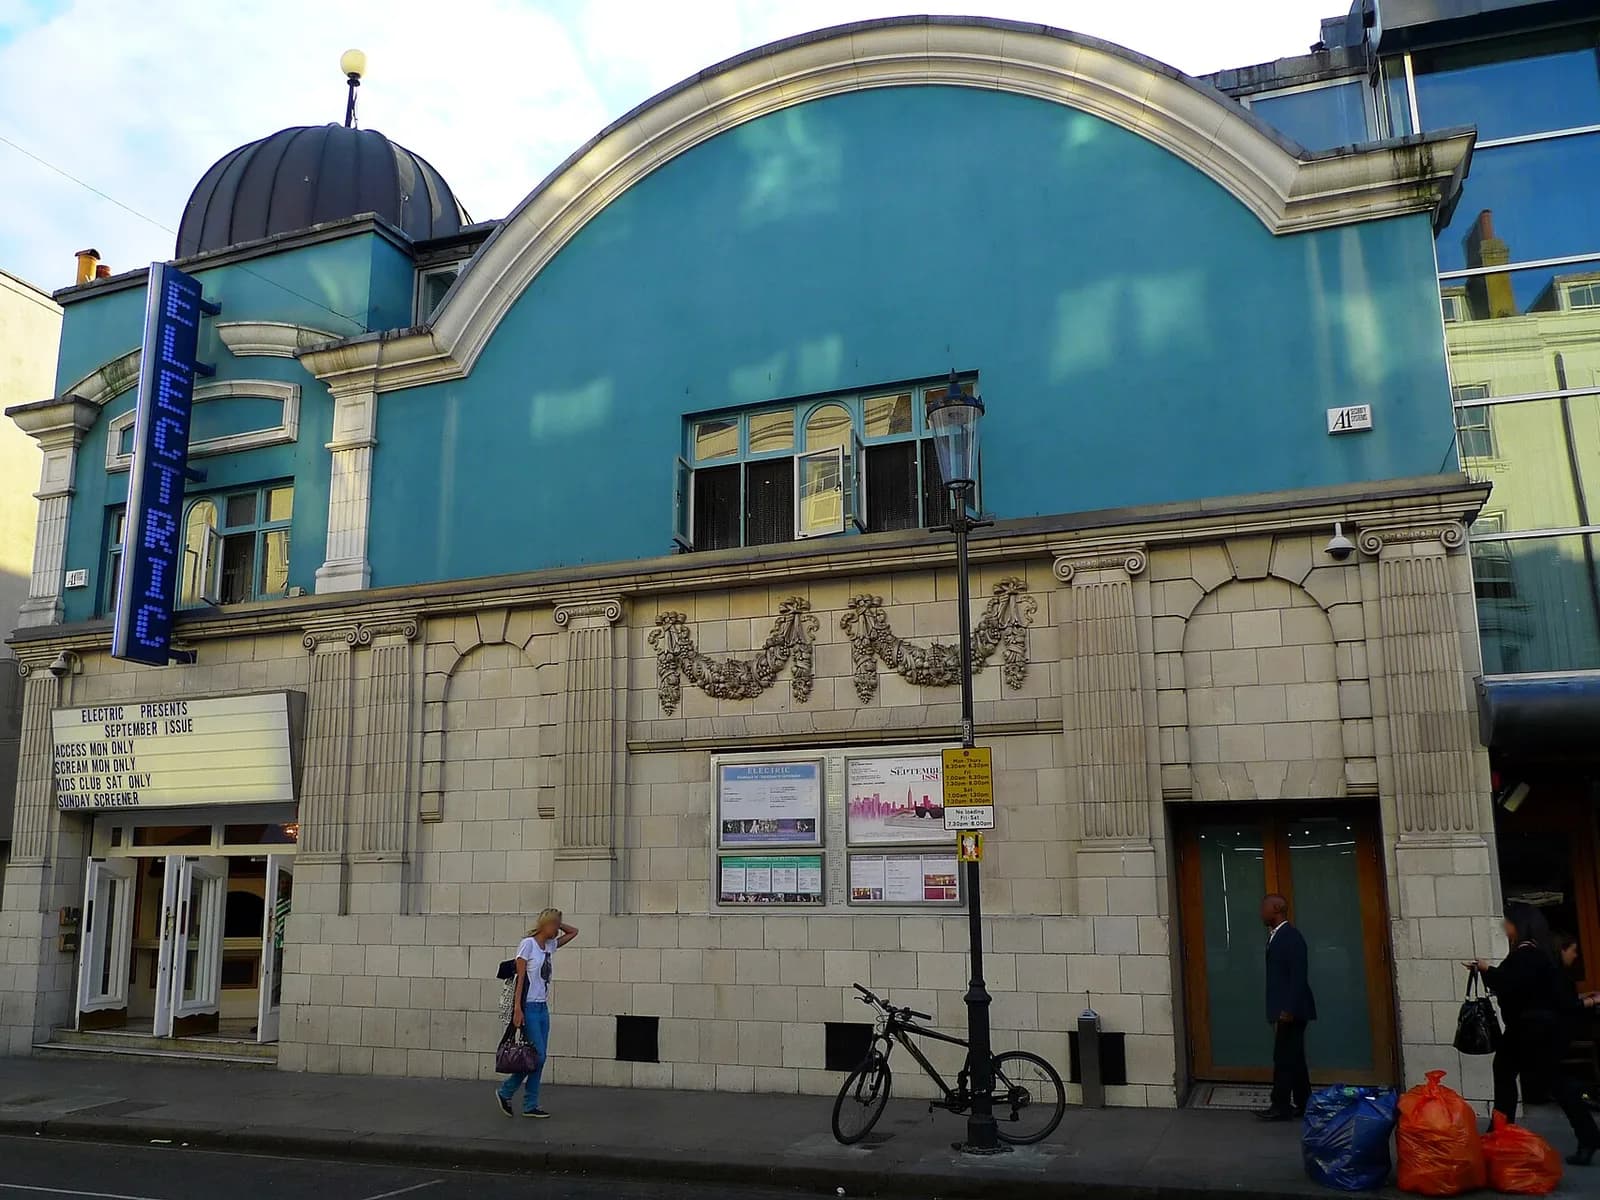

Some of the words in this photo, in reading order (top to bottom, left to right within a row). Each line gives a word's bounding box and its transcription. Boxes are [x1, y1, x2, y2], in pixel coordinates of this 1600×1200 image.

[1333, 409, 1352, 430] A1
[136, 280, 197, 648] ELECTRIC
[82, 707, 124, 723] ELECTRIC
[140, 702, 188, 718] PRESENTS
[104, 722, 158, 738] SEPTEMBER
[165, 719, 192, 734] ISSUE
[56, 743, 86, 758] ACCESS
[90, 742, 108, 756] MON
[112, 740, 134, 755] ONLY
[55, 760, 88, 775] SCREAM
[92, 758, 110, 773] MON
[114, 757, 136, 772] ONLY
[747, 766, 790, 775] ELECTRIC
[890, 767, 938, 776] SEPTEMB
[56, 778, 76, 792] KIDS
[80, 776, 100, 790] CLUB
[106, 776, 122, 790] SAT
[129, 774, 151, 788] ONLY
[58, 793, 90, 808] SUNDAY
[94, 792, 139, 807] SCREENER
